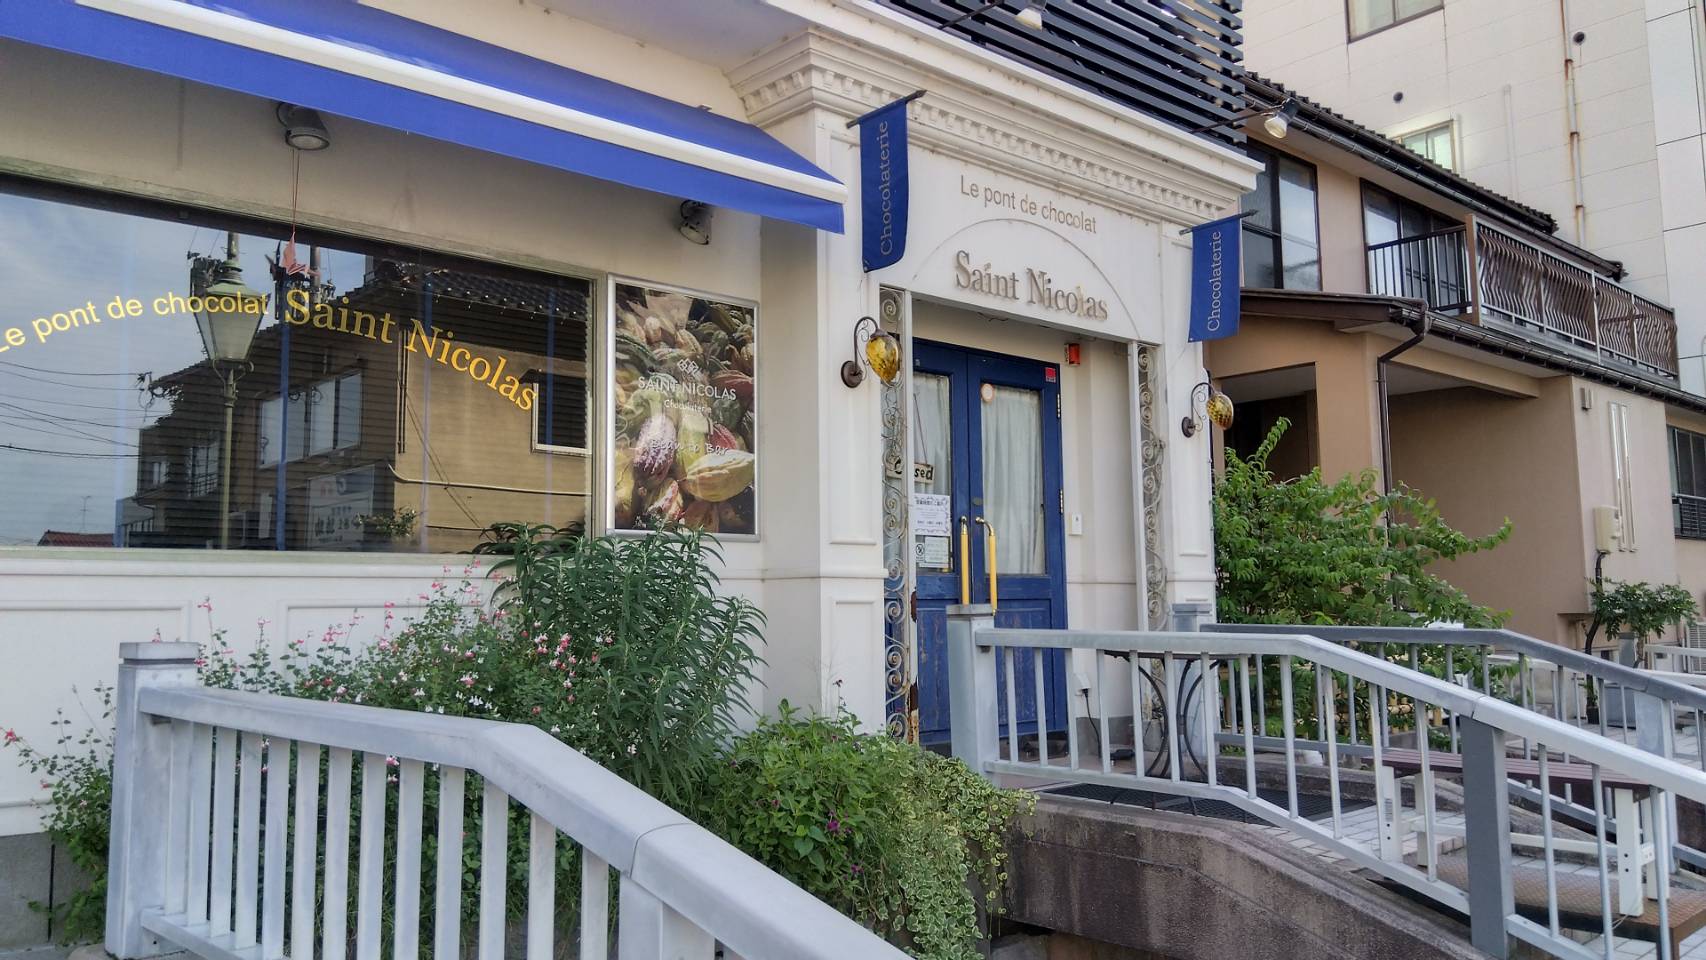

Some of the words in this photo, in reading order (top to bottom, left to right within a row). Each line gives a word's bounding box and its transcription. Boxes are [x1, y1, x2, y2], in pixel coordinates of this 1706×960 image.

[876, 120, 893, 256] Chocolaterie
[960, 174, 979, 198] Le
[984, 186, 1016, 209] pont
[1020, 193, 1038, 216] de
[1041, 200, 1097, 234] chocolat
[955, 249, 1020, 301] Saint
[1025, 267, 1108, 321] Nicolas
[1207, 231, 1222, 332] Chocolaterie
[32, 300, 101, 343] pont
[106, 295, 144, 319] de
[153, 291, 269, 316] chocolat
[284, 288, 396, 344] Saint
[403, 318, 538, 411] Nicolas
[638, 375, 679, 393] SAINT
[682, 382, 737, 401] NICOLAS
[705, 442, 729, 456] Bar
